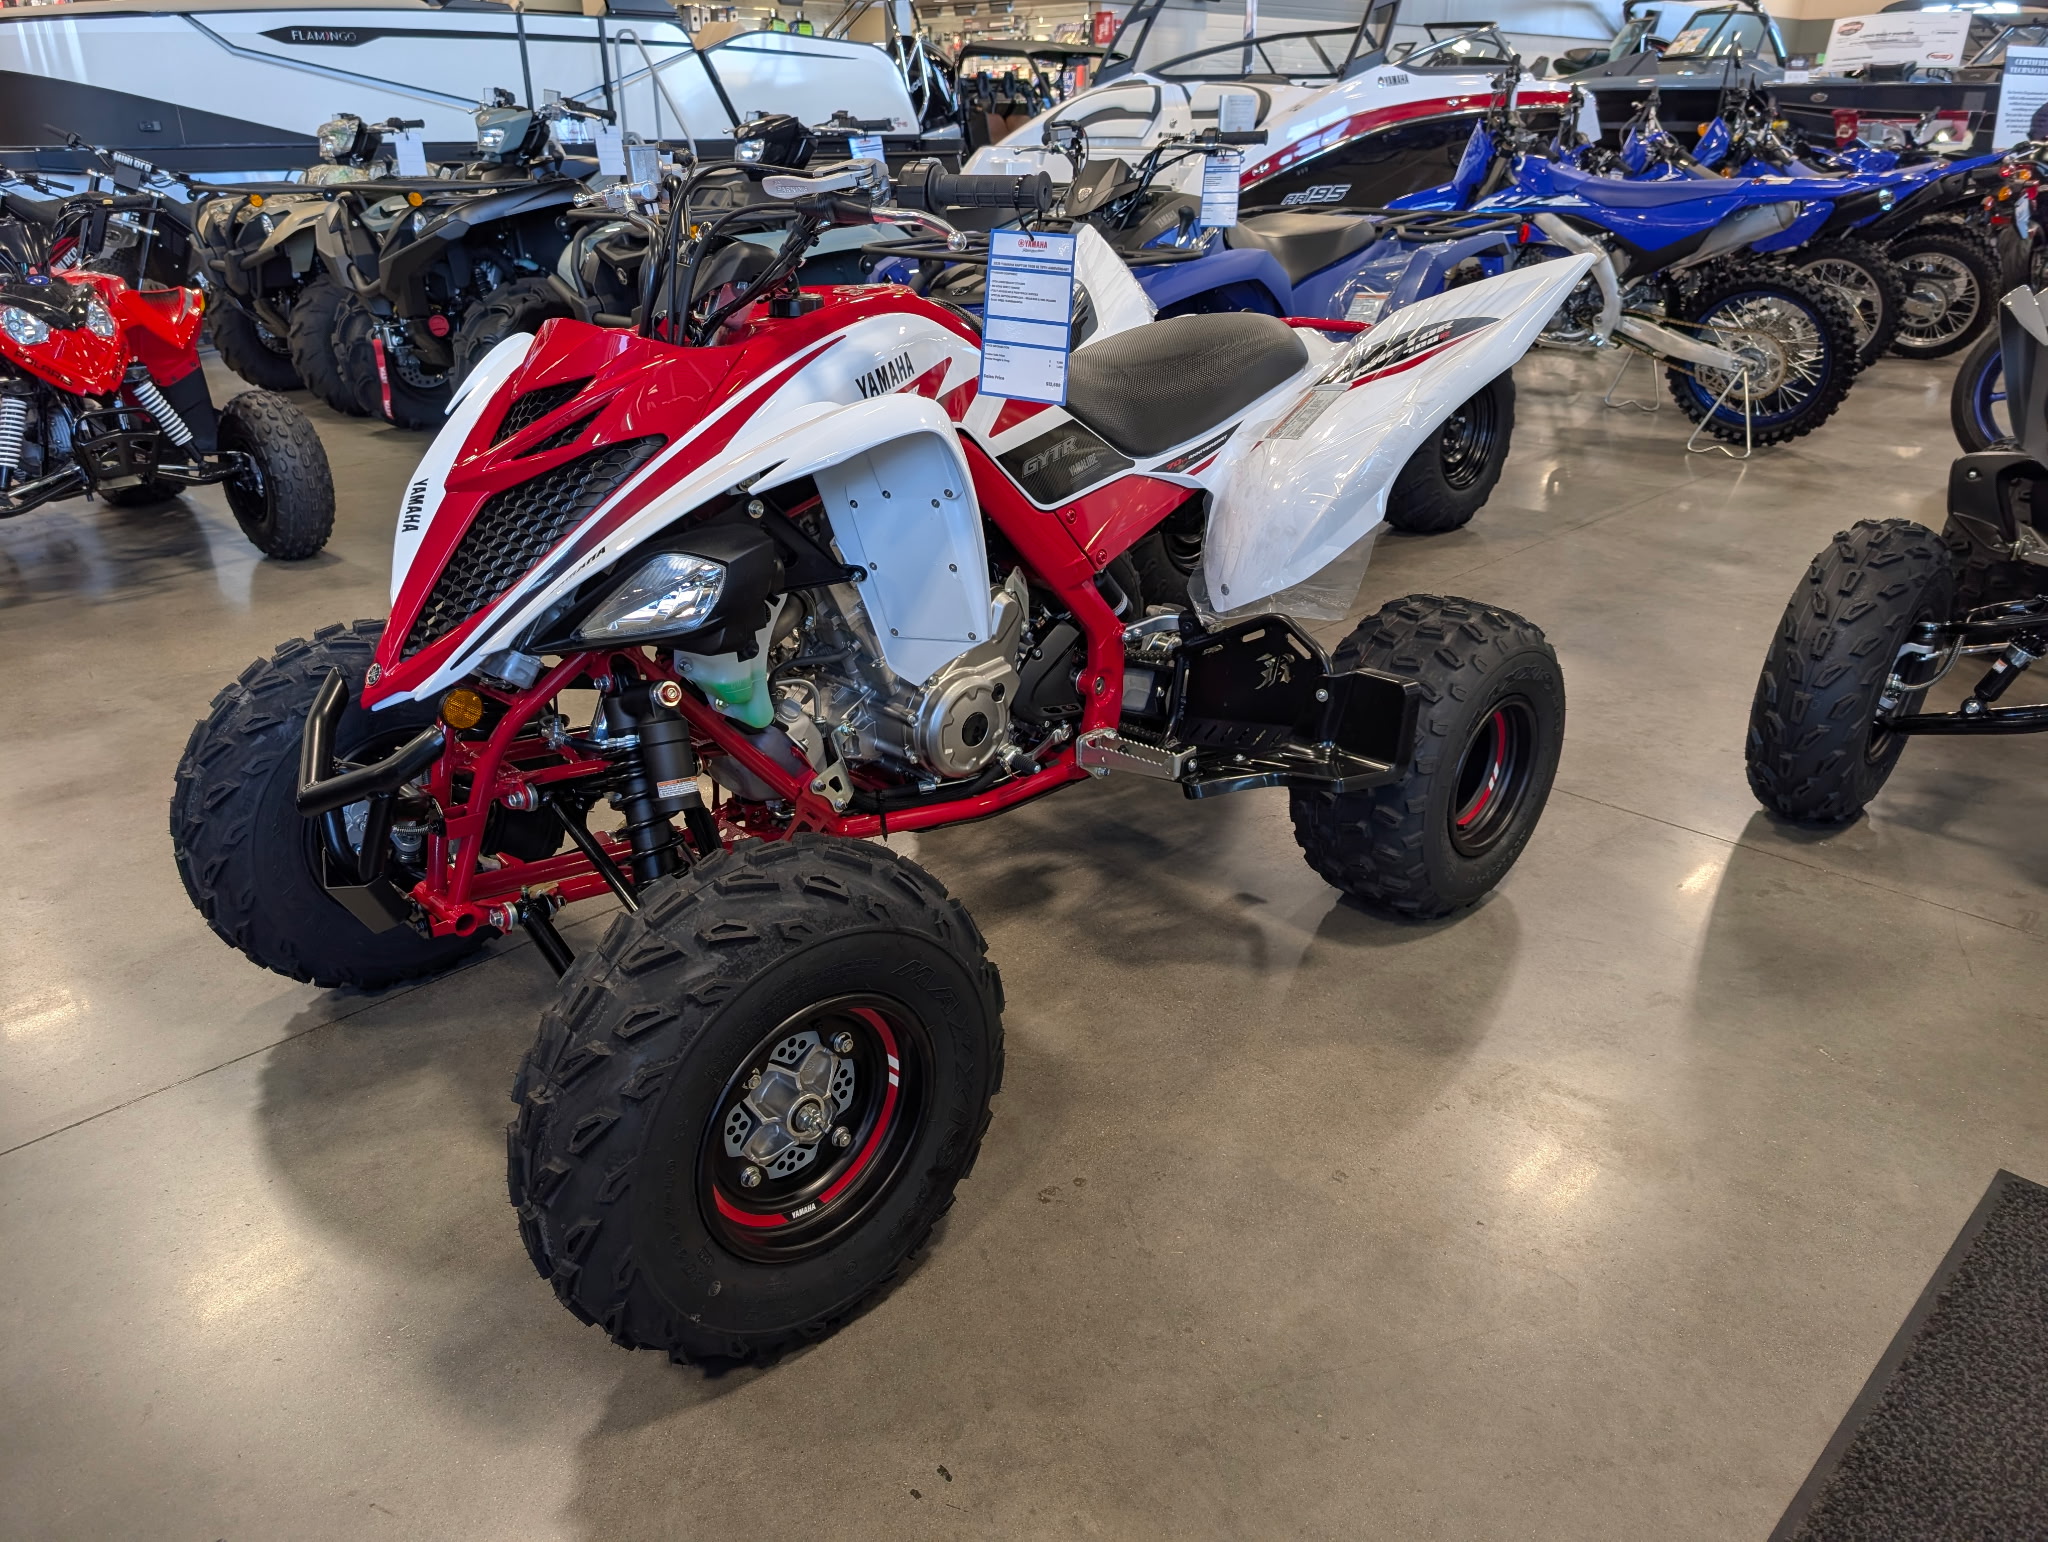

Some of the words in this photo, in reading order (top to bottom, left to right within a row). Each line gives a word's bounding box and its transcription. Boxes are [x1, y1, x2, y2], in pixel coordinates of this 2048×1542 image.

[291, 29, 357, 42] FLAMINGO
[1025, 239, 1048, 250] YAMAHA
[855, 352, 915, 399] YAMAHA
[1022, 436, 1078, 478] GYTR
[1069, 453, 1099, 476] YAMALUBE
[402, 478, 429, 533] YAMAHA
[791, 1202, 817, 1219] YAMAHA
